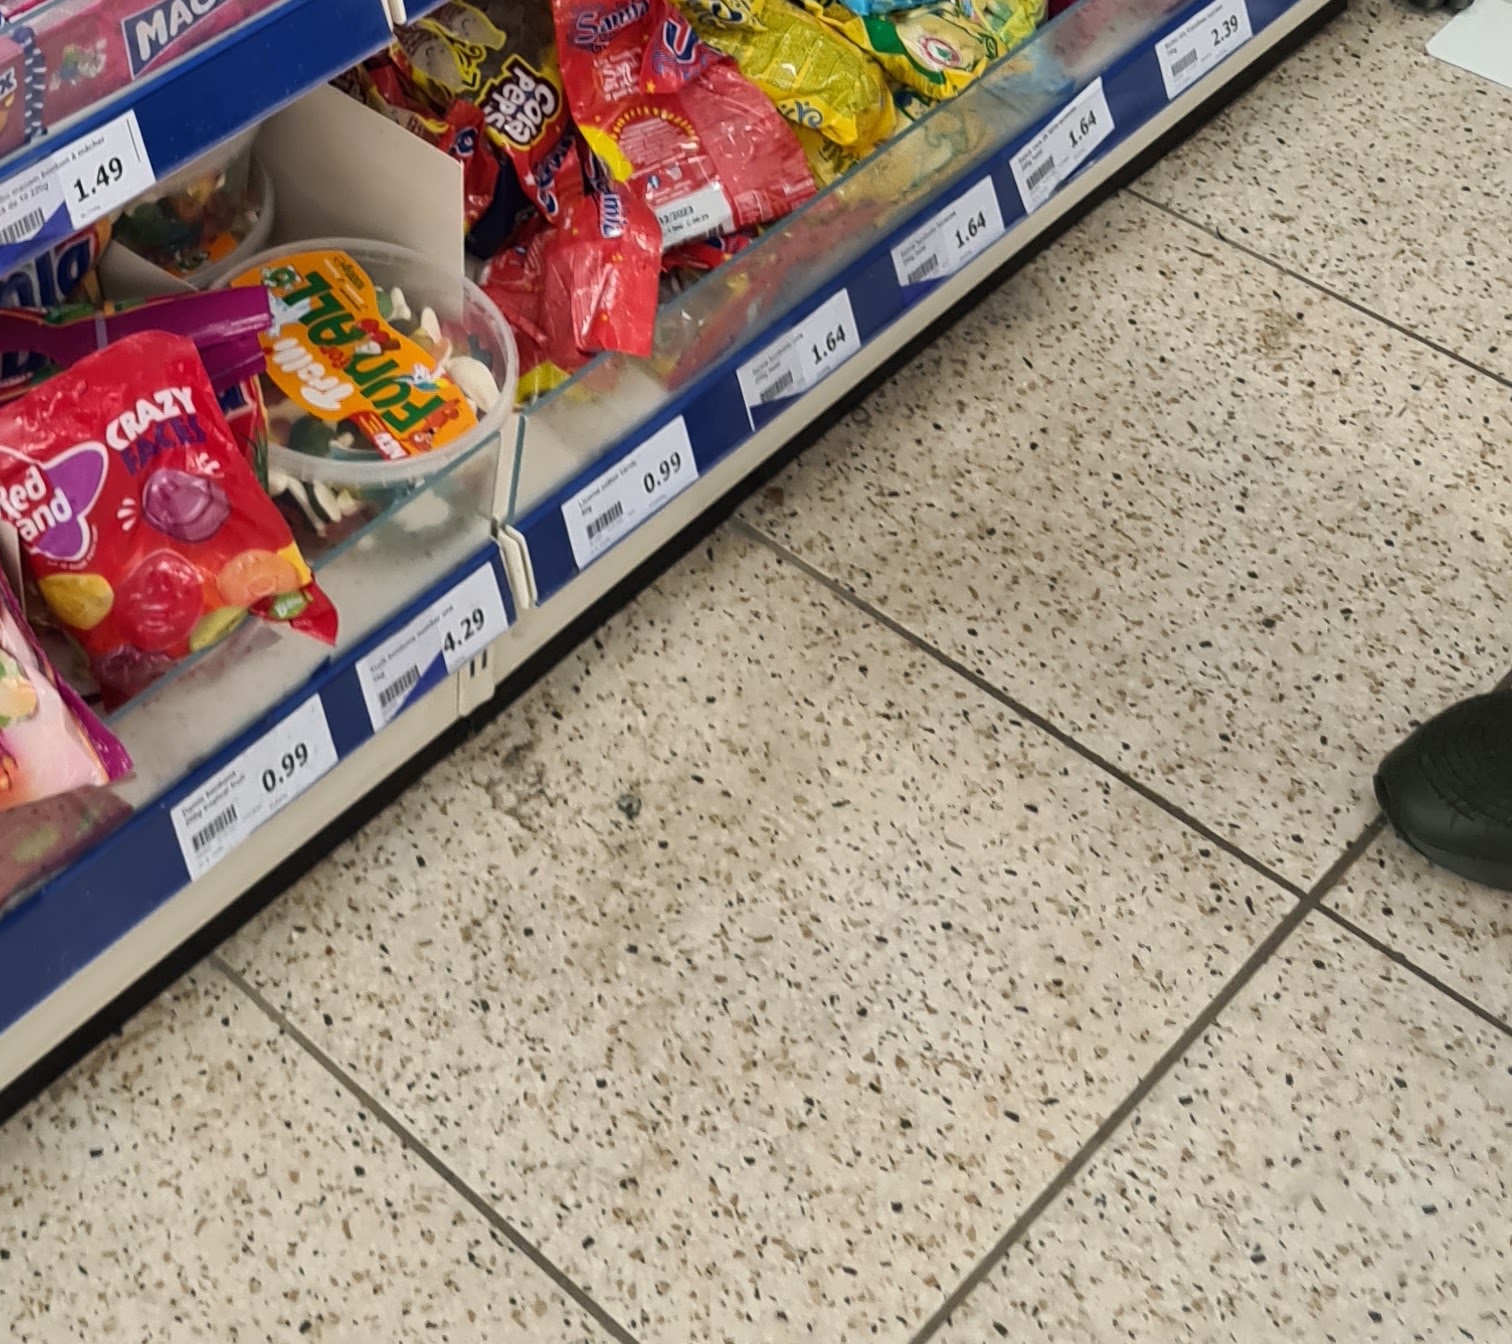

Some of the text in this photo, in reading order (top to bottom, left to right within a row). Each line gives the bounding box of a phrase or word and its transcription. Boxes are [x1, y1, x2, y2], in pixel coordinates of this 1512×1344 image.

[1210, 14, 1239, 47] 2.39
[1068, 108, 1098, 148] 1.64
[73, 157, 124, 203] 1.49
[954, 209, 987, 249] 1.64
[811, 322, 847, 365] 1.64
[104, 384, 198, 453] CRAZY
[643, 450, 682, 495] 0.99
[443, 607, 486, 653] 4.29
[261, 742, 309, 793] 0.99
